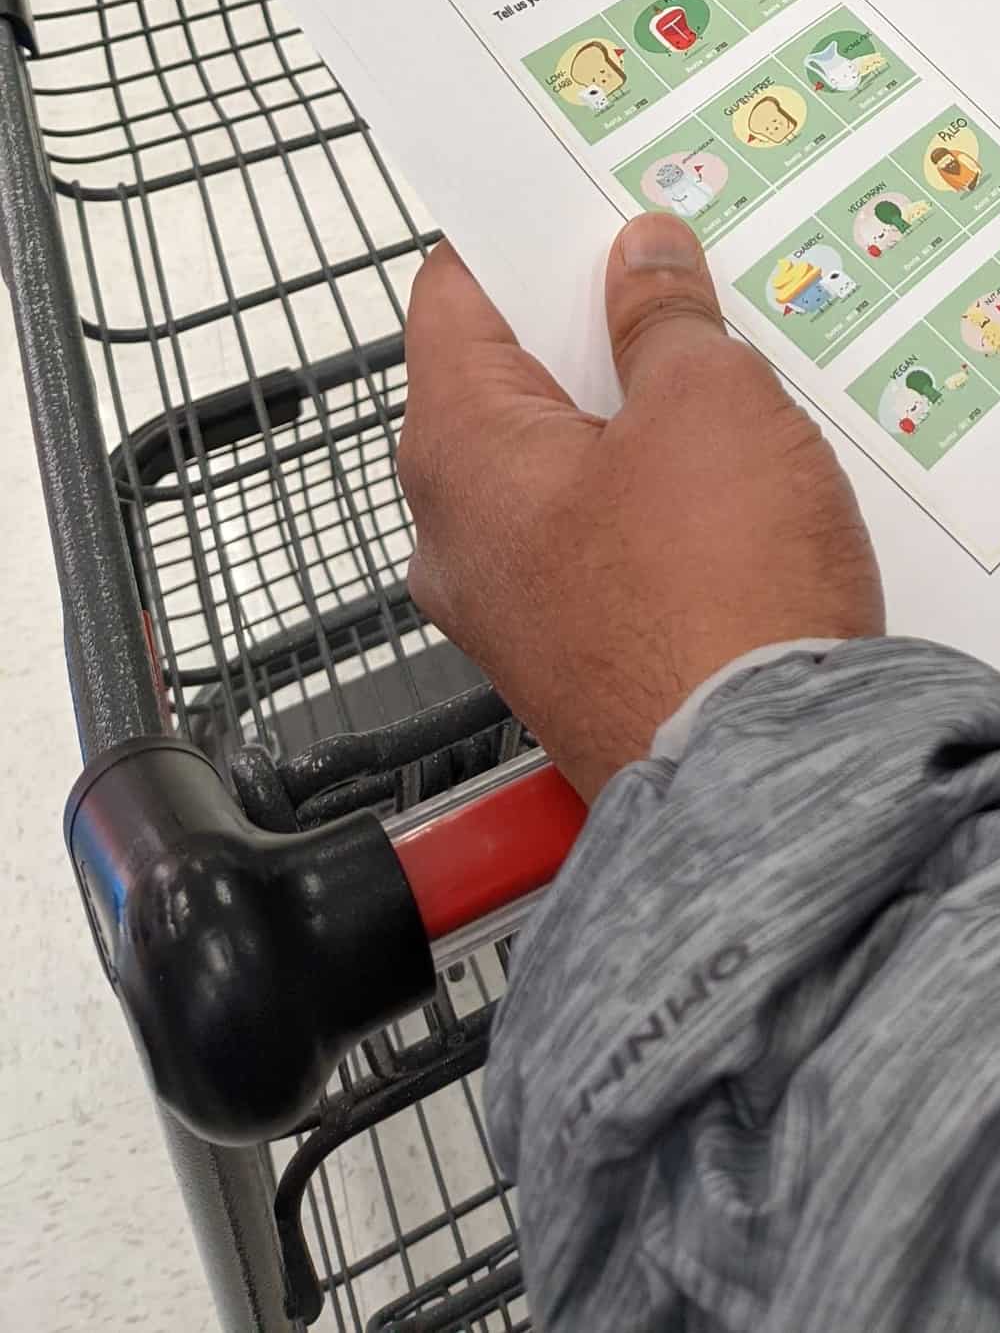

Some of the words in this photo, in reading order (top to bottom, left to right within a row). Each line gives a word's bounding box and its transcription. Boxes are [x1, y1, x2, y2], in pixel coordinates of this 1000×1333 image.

[493, 6, 514, 22] Tell
[513, 0, 527, 12] us
[938, 117, 968, 143] PALEO
[889, 353, 919, 382] VEGAN
